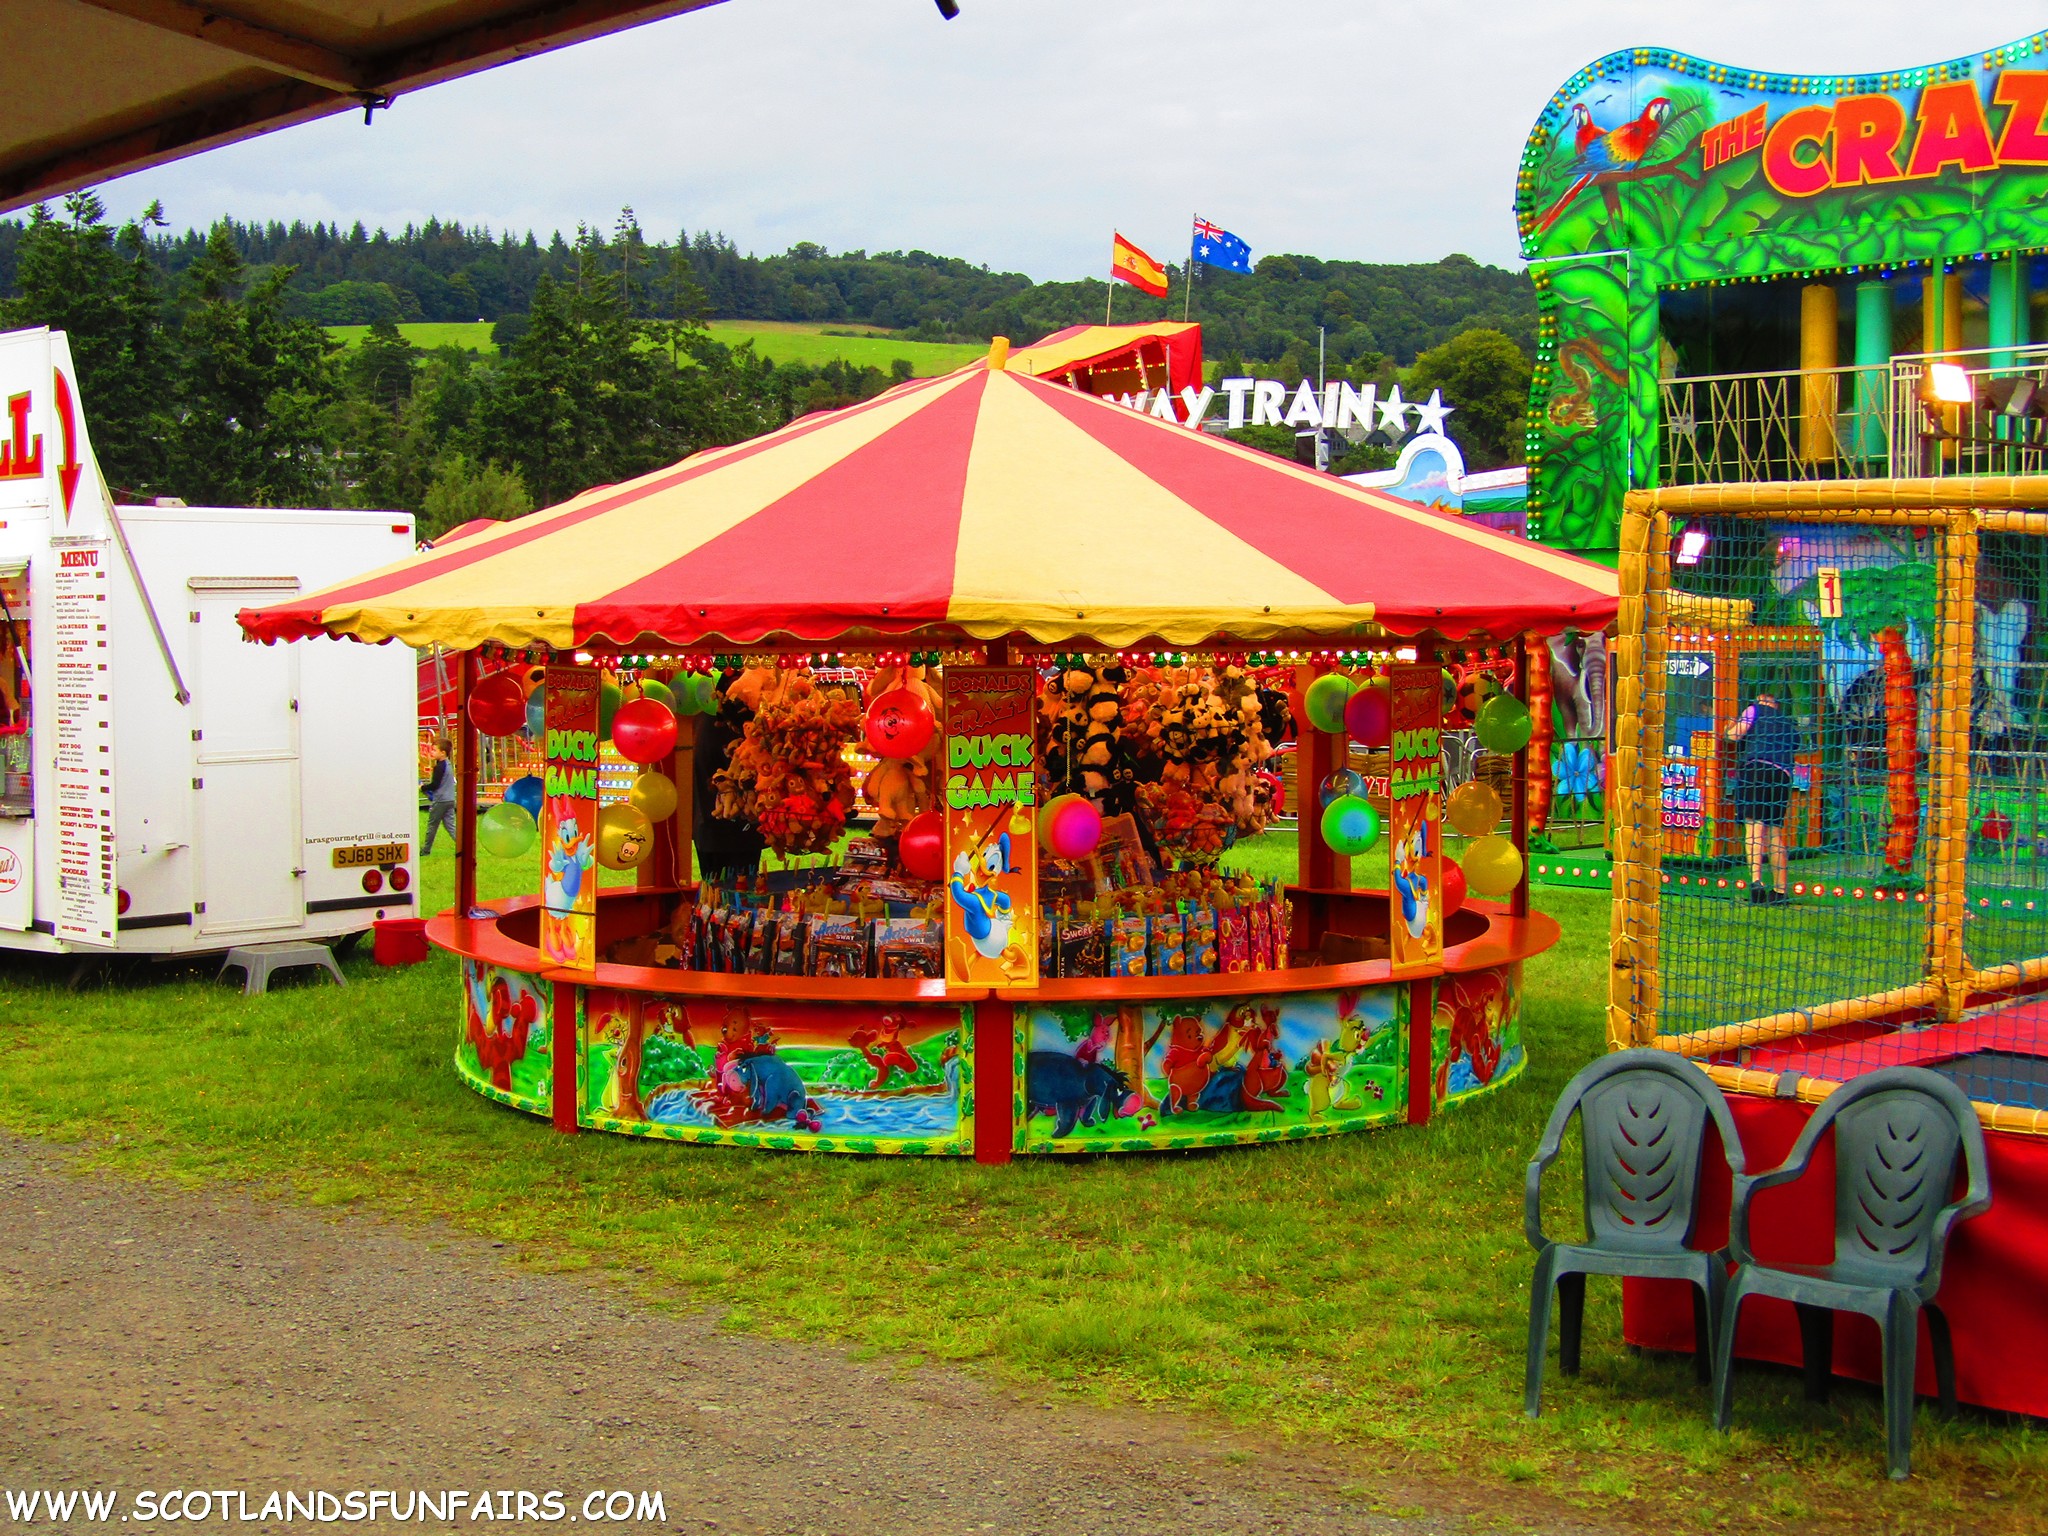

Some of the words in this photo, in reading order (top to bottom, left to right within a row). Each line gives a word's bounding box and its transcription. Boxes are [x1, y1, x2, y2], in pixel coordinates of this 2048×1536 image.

[1700, 101, 1769, 171] THE
[1221, 377, 1376, 431] TRAIN
[60, 550, 99, 567] MENU
[947, 674, 1032, 693] DONALDS
[945, 689, 1034, 737] CRAZY
[547, 728, 598, 762] DUCK
[949, 733, 1034, 769] DUCK
[1393, 727, 1440, 762] DUCK
[545, 765, 597, 801] GAME
[946, 771, 1035, 810] GAME
[1391, 762, 1440, 800] GAME
[61, 867, 88, 876] NOODLES
[338, 848, 373, 864] SJ68
[377, 846, 402, 862] SHX
